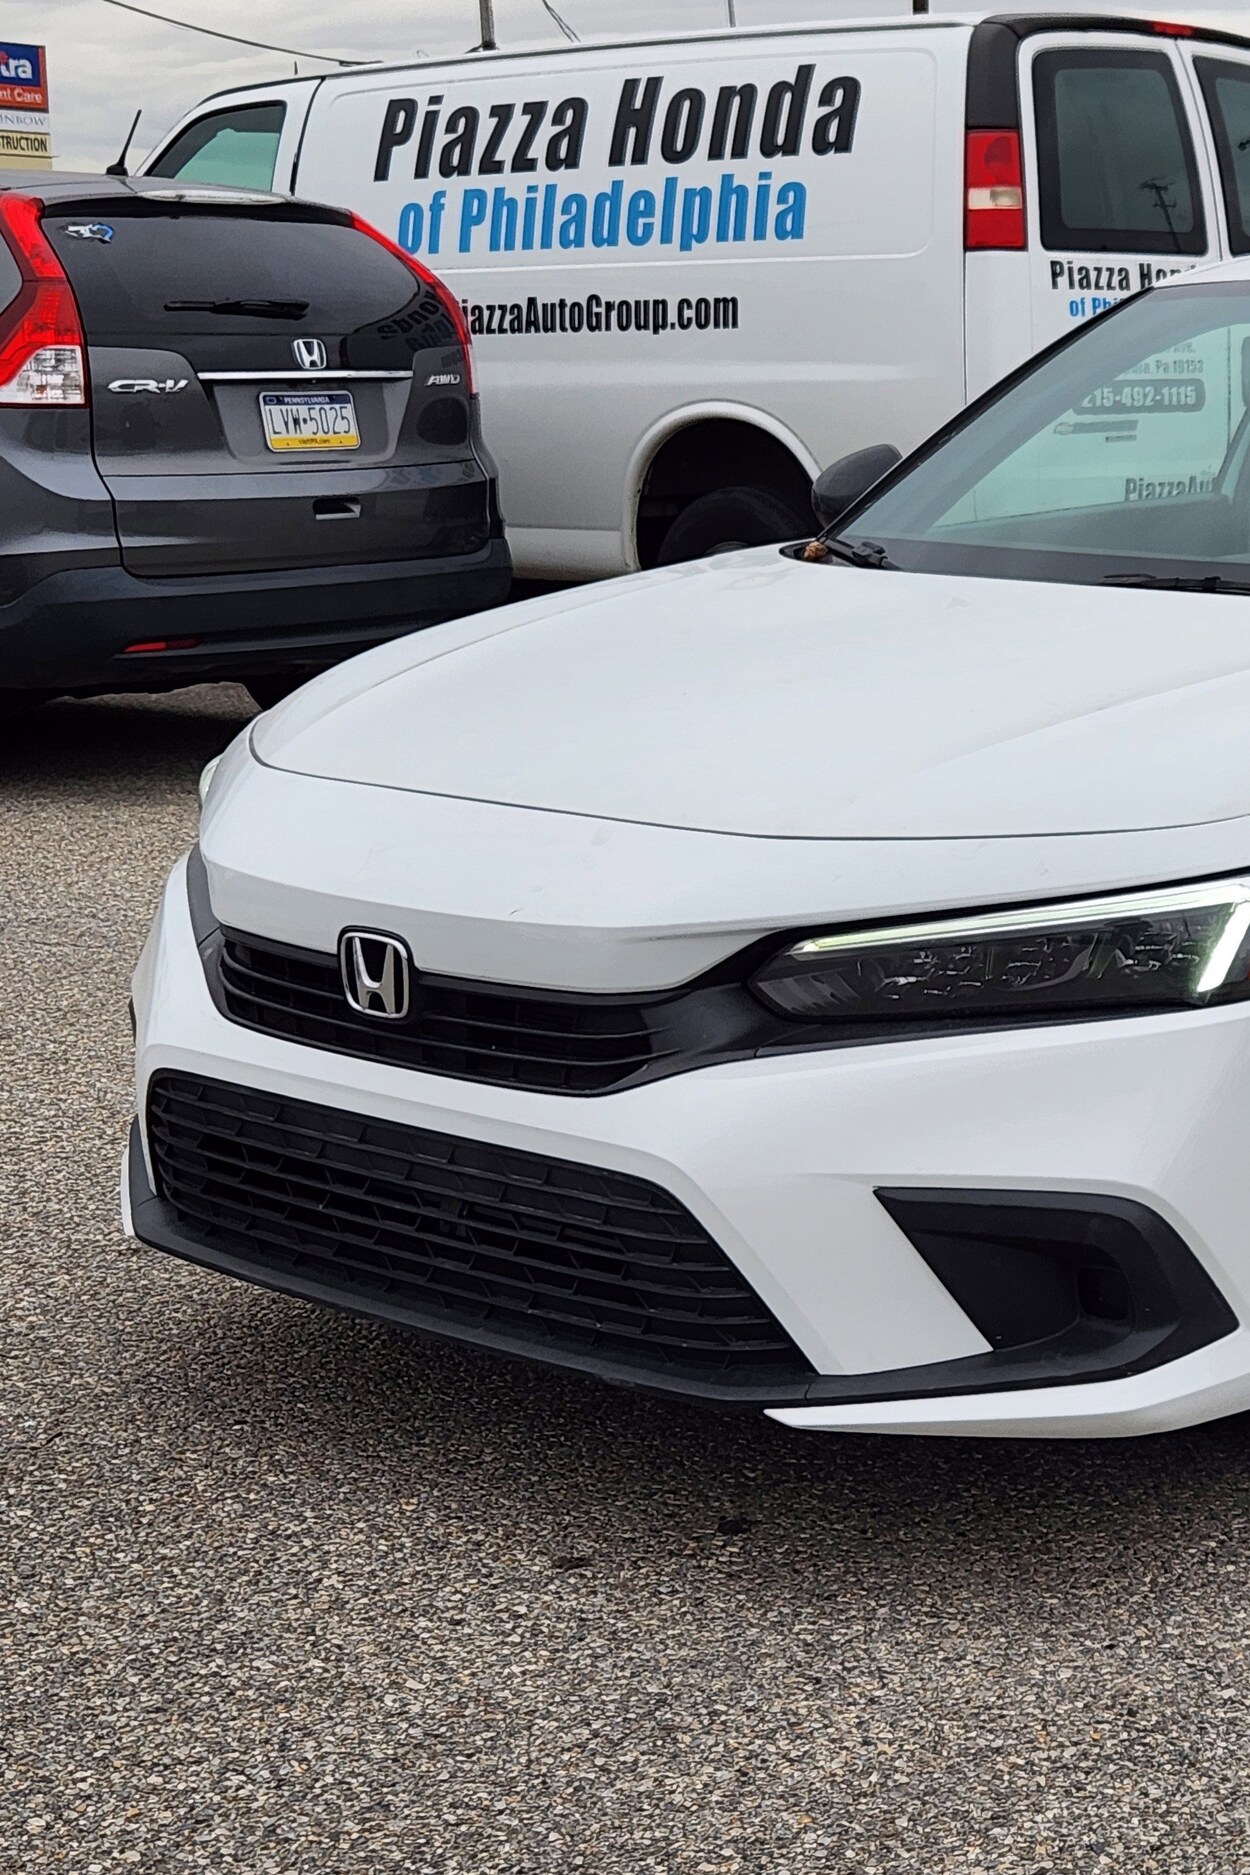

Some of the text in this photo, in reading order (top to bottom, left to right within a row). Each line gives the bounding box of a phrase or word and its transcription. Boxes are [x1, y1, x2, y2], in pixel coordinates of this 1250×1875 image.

[14, 87, 43, 104] Care
[373, 64, 861, 182] Piazza Honda
[398, 171, 807, 255] of Philadelphia
[1050, 260, 1131, 291] Piazza
[462, 294, 739, 335] iazzaAutoGroup.com
[1069, 297, 1086, 317] of
[107, 379, 188, 393] CR-V
[425, 374, 461, 386] AWD
